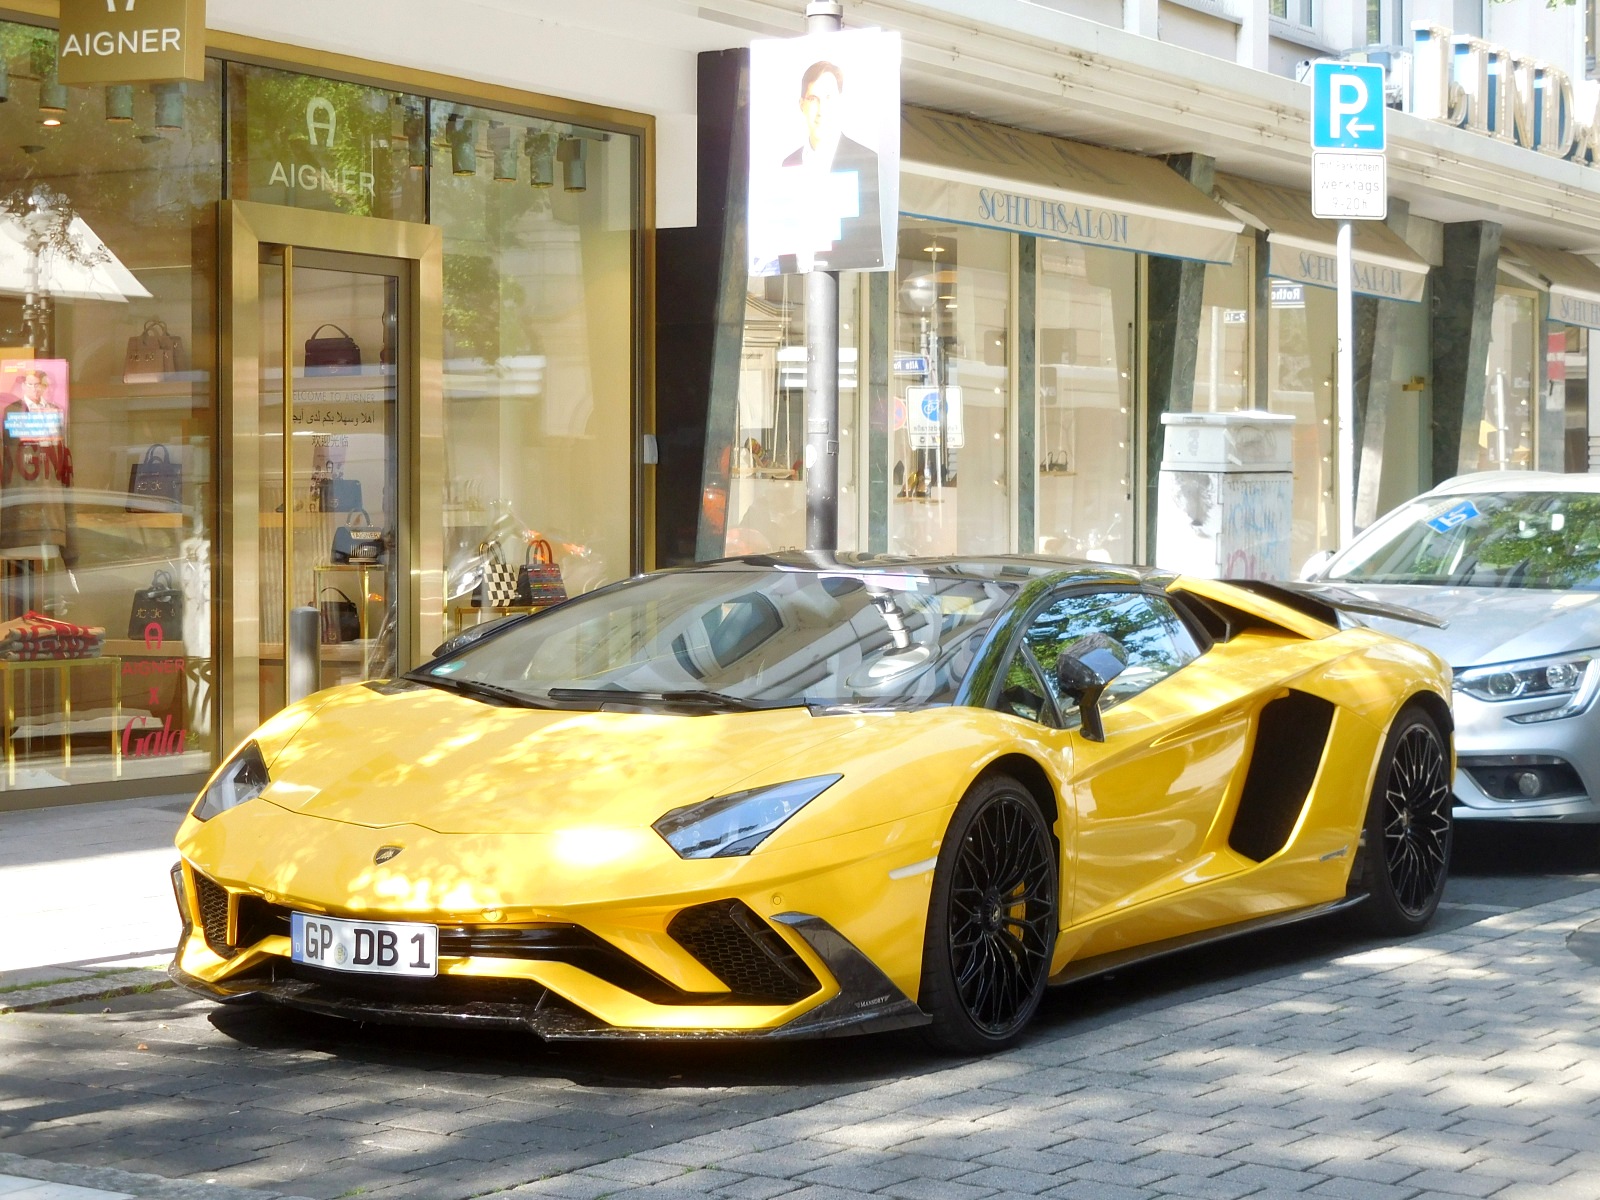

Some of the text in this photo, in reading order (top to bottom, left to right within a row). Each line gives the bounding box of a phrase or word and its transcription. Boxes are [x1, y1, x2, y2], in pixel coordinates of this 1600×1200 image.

[61, 27, 181, 57] AIGNER
[1330, 73, 1368, 139] P
[268, 161, 376, 197] AIGNER
[1321, 180, 1380, 195] werktags
[978, 187, 1128, 244] SCHUHSALON
[1299, 251, 1402, 295] SCHUSALON
[293, 392, 327, 401] ELCOME
[345, 393, 376, 403] AIGNER
[312, 435, 349, 448] 欢迎光临
[122, 658, 186, 678] AIGNER
[121, 714, 187, 759] Gala
[305, 921, 430, 969] GP DB 1
